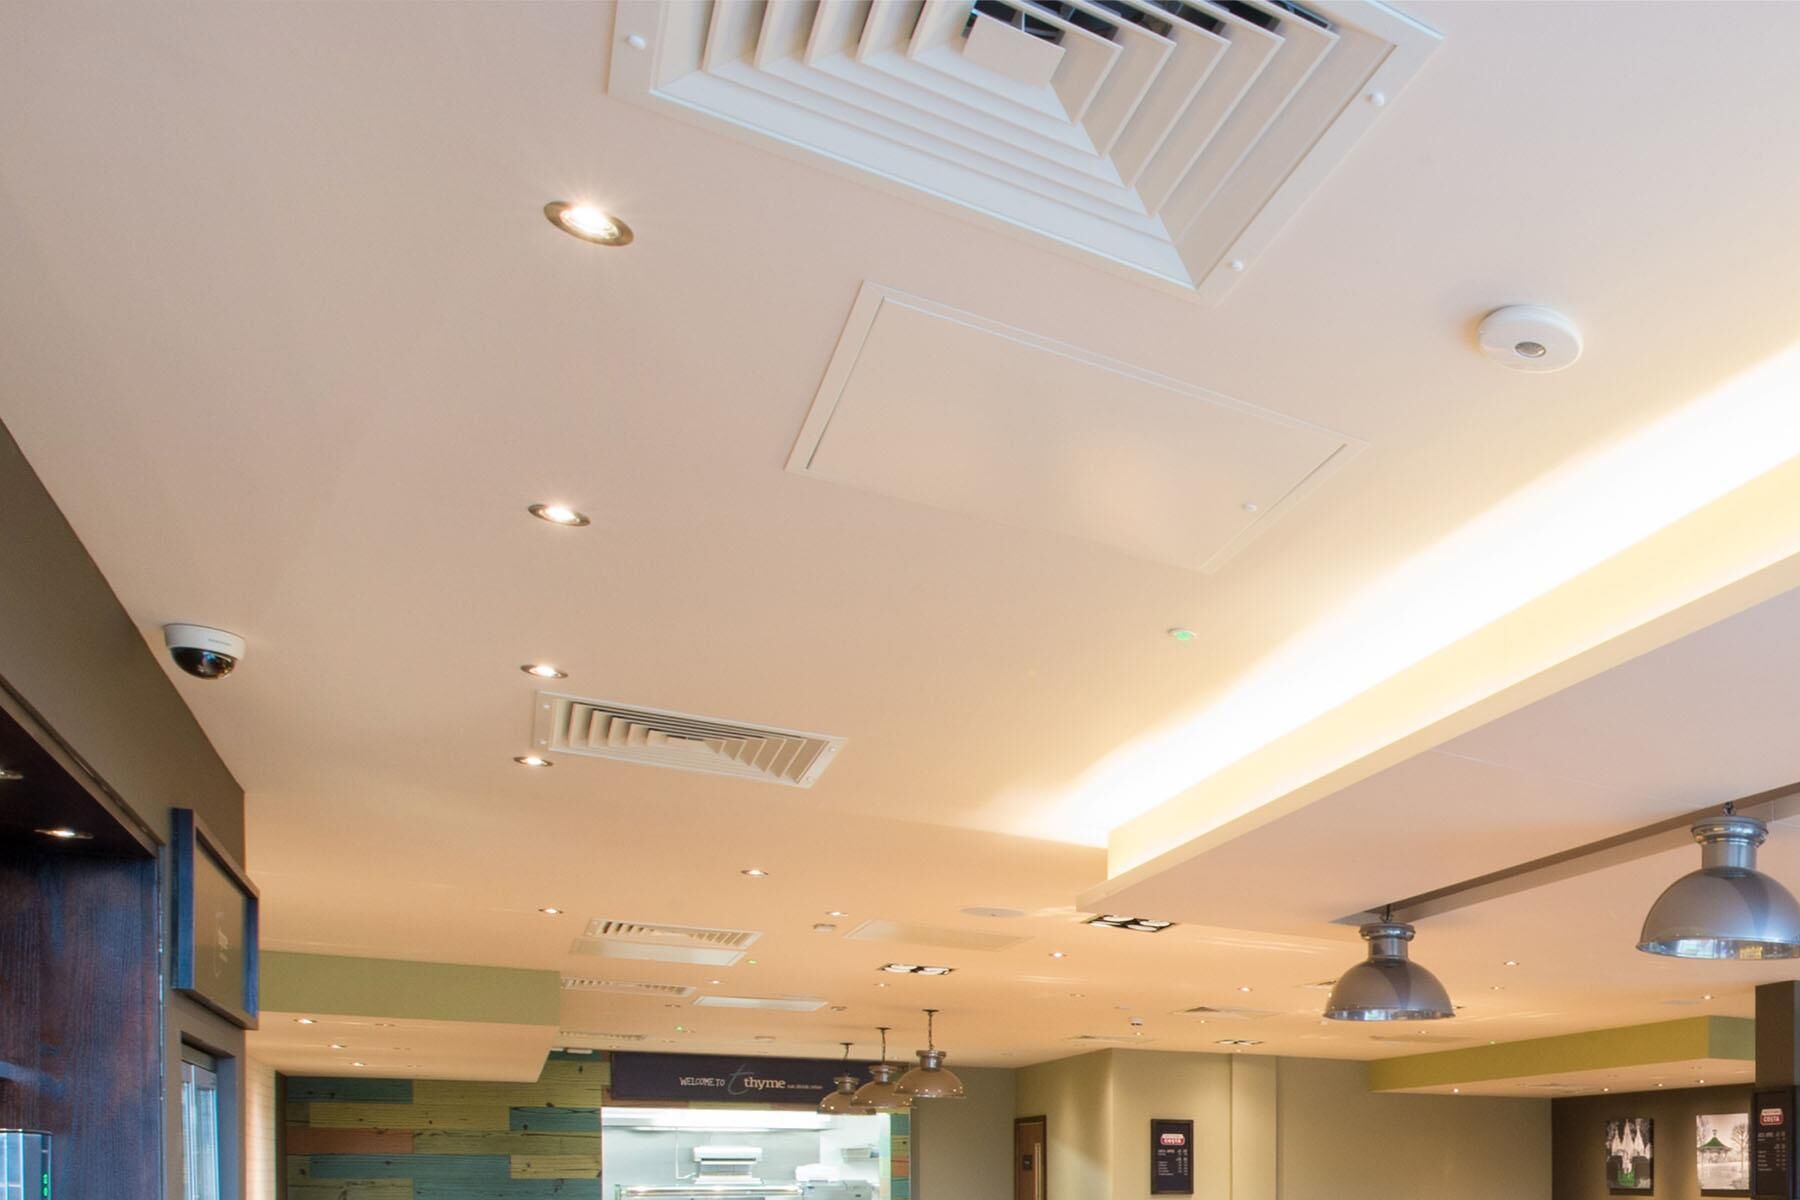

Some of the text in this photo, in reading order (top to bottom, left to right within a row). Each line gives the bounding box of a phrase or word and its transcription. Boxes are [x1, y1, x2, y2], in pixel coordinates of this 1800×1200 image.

[679, 1077, 714, 1087] WELCOME
[715, 1078, 726, 1088] TO
[743, 1076, 786, 1091] thyme
